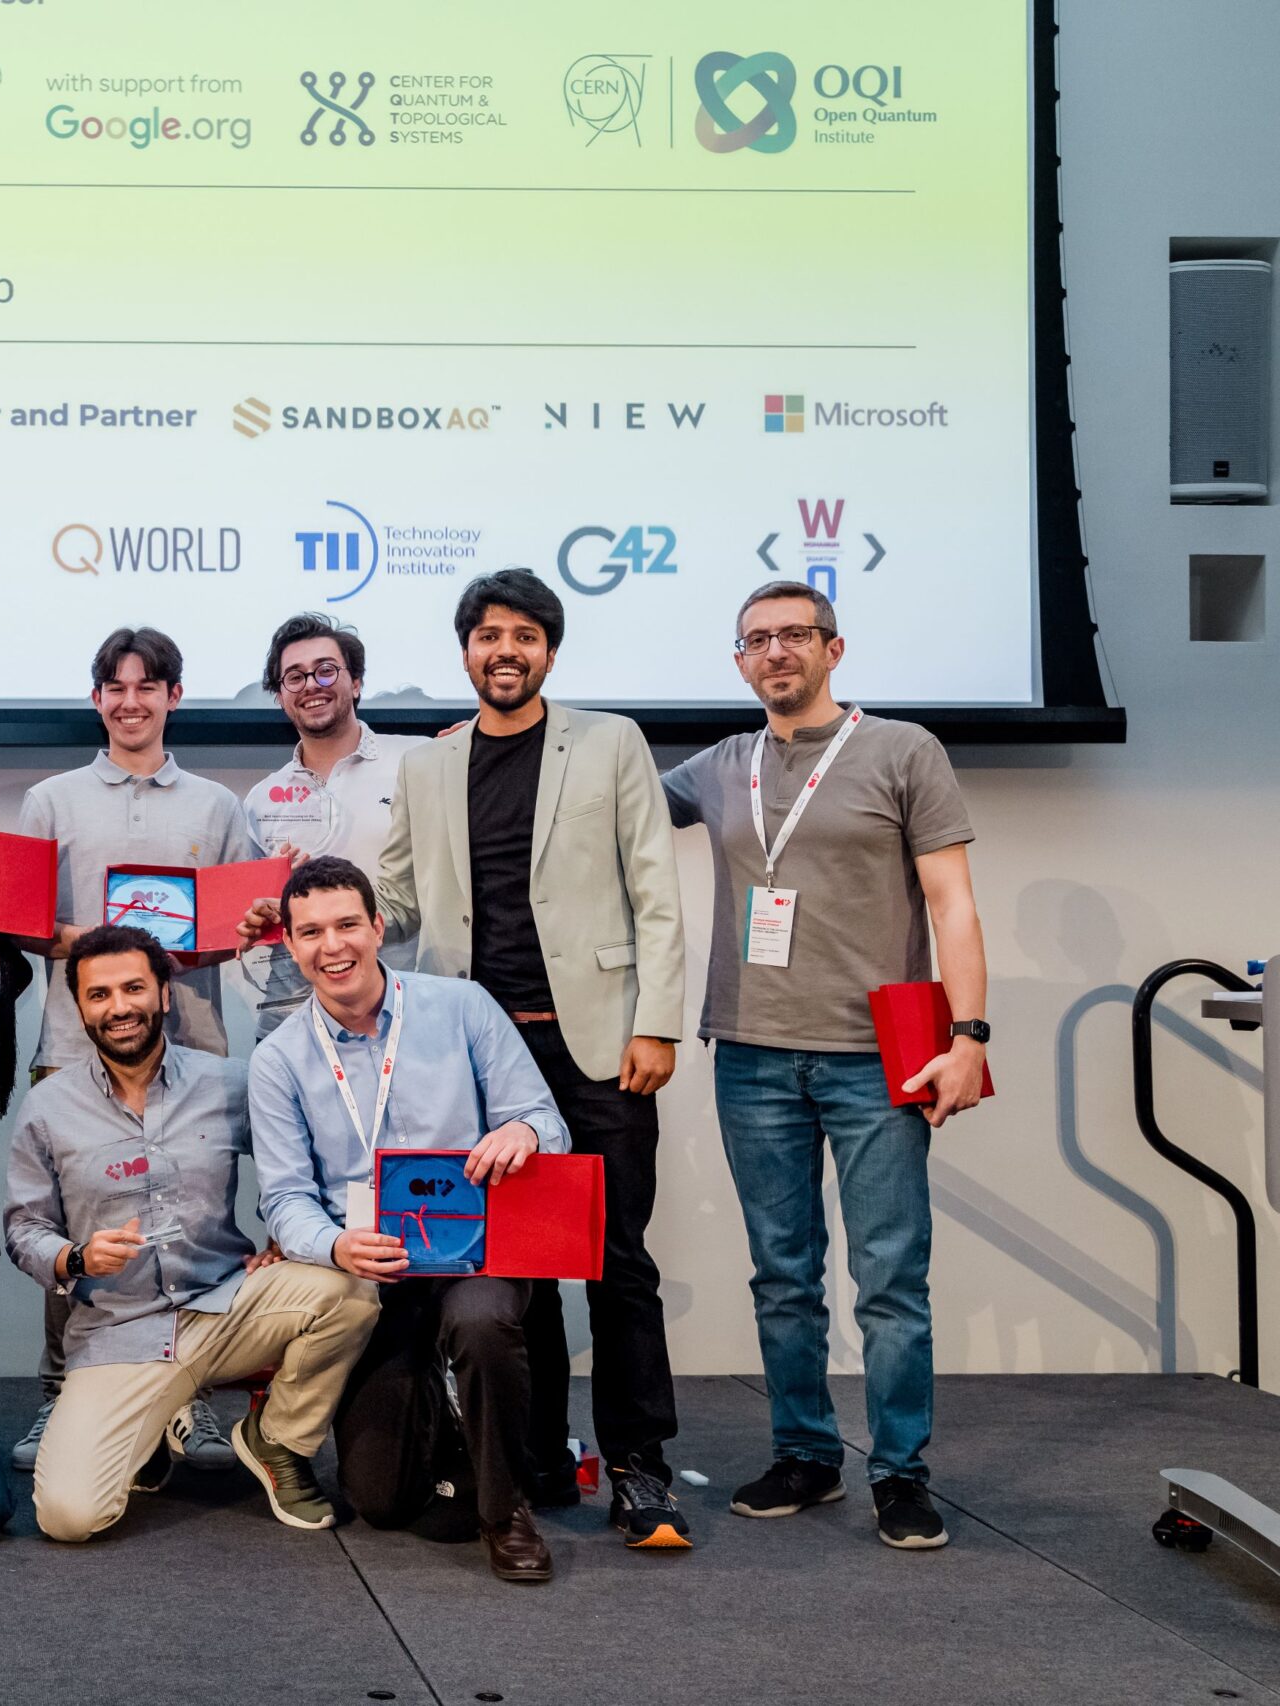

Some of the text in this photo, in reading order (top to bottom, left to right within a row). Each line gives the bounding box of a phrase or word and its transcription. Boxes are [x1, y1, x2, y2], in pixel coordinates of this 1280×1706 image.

[46, 73, 242, 97] with support from
[390, 75, 493, 88] CENTER FOR
[571, 79, 619, 95] CERN
[814, 65, 902, 106] OQI
[390, 94, 488, 107] QUANTUM &
[390, 112, 507, 125] TOPOLOGICAL
[814, 108, 937, 126] Open Quantum
[45, 104, 251, 149] Google.org
[390, 131, 463, 144] SYSTEMS
[815, 130, 874, 143] Institute
[11, 403, 68, 426] and
[80, 404, 197, 427] Partner
[815, 401, 948, 427] Microsoft
[797, 499, 845, 539] W
[384, 527, 480, 542] Technology
[295, 532, 359, 571] TII
[387, 544, 475, 557] Innovation
[387, 561, 455, 574] Institute
[557, 525, 678, 596] G42
